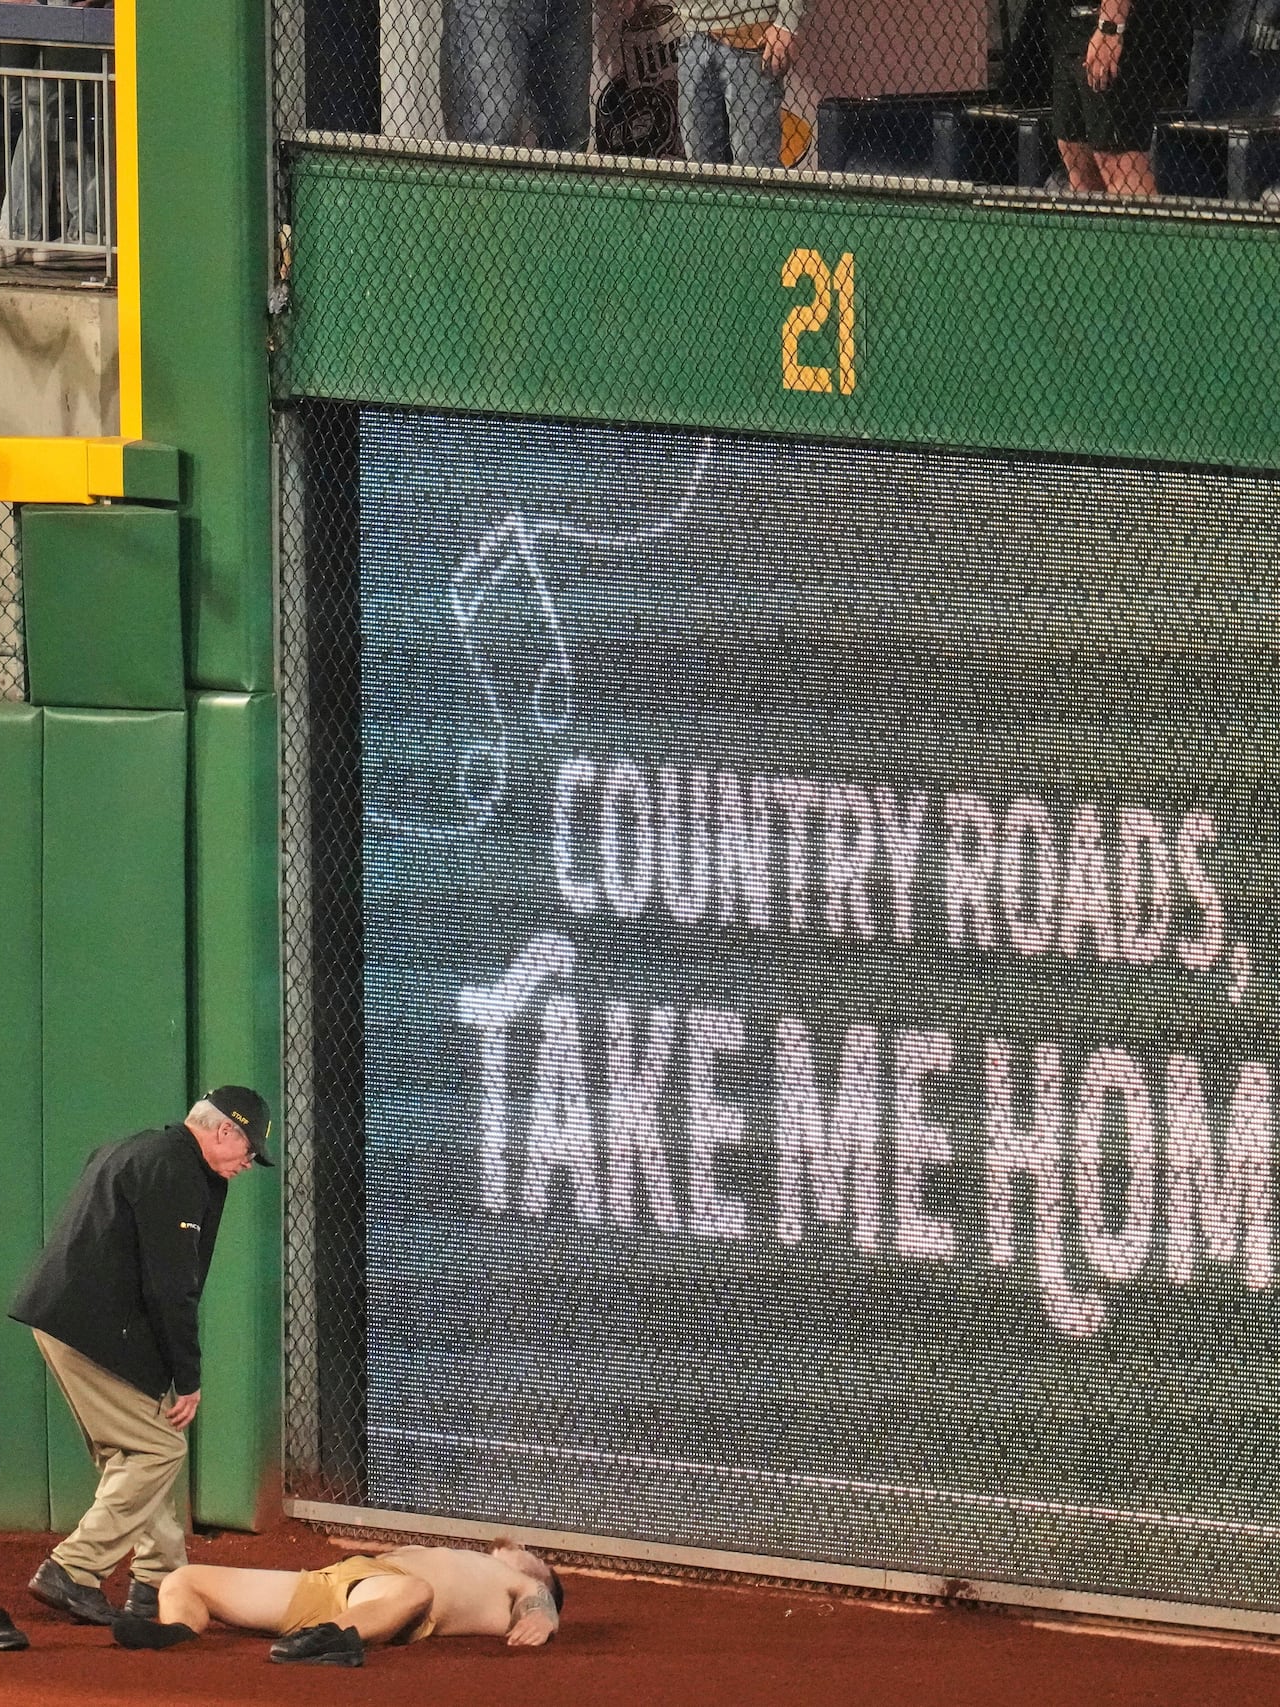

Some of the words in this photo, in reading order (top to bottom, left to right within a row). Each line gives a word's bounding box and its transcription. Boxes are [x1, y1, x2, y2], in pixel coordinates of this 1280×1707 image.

[781, 248, 855, 395] 21
[552, 758, 930, 944] COUNTRY
[943, 789, 1252, 1004] ROADS,
[231, 1111, 250, 1125] STAFF
[457, 932, 750, 1240] TAKE
[773, 1016, 957, 1261] ME
